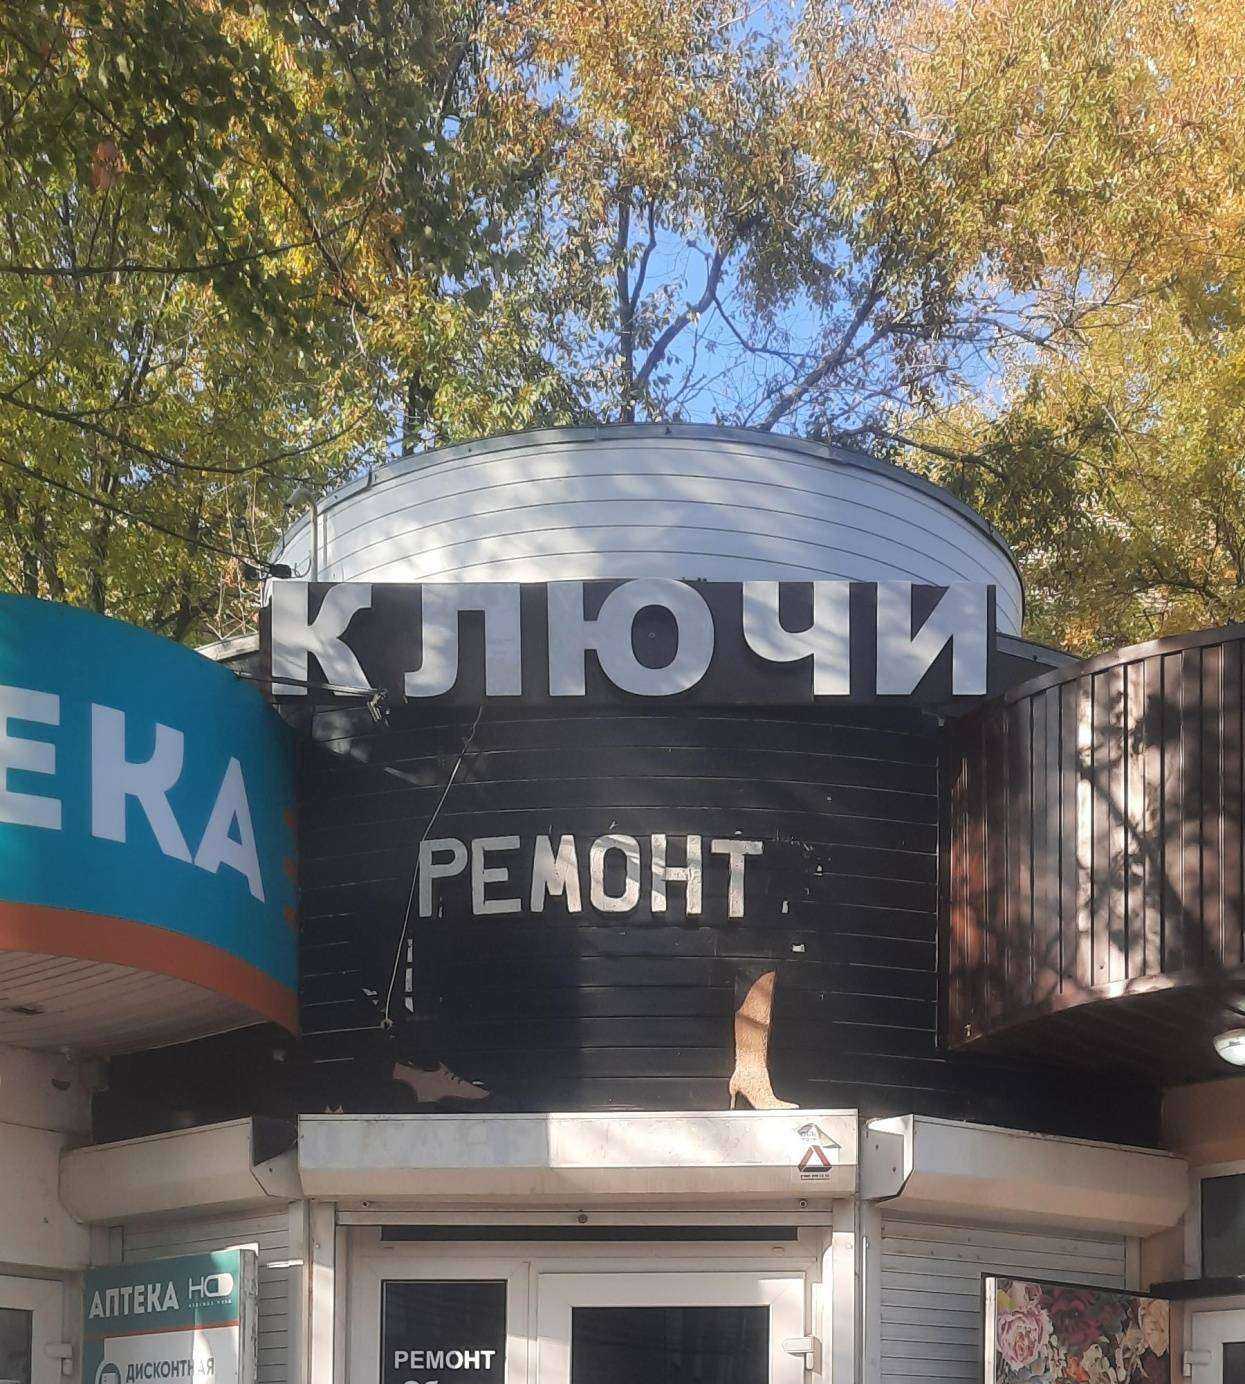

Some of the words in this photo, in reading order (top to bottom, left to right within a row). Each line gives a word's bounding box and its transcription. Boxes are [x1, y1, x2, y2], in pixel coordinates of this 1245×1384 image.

[271, 578, 996, 697] КЛЮЧИ
[418, 833, 763, 918] РЕМОНТ
[88, 1281, 180, 1319] АПТЕКА
[393, 1350, 496, 1370] РЕМОНТ
